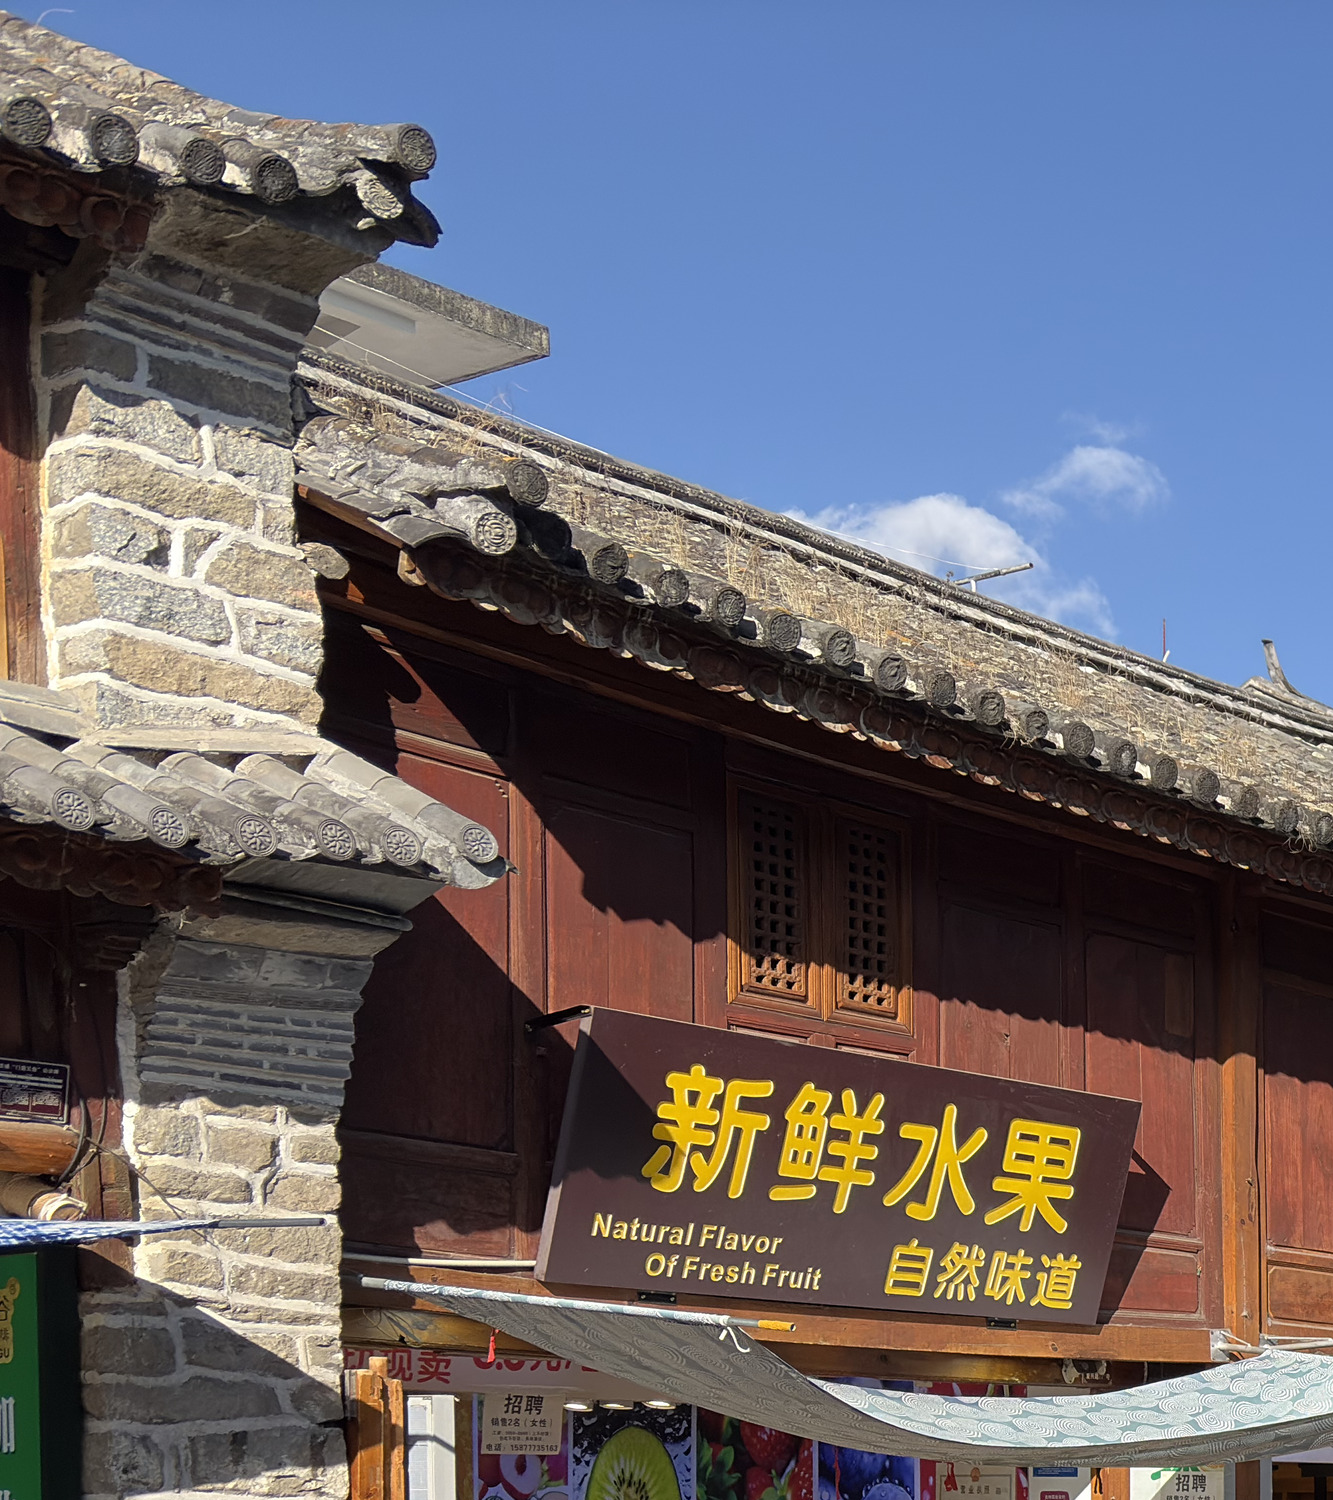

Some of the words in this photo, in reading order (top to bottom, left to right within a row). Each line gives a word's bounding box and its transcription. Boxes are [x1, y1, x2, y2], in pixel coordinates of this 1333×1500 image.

[641, 1062, 1082, 1235] 新鲜水果
[591, 1211, 692, 1247] Natural
[698, 1222, 783, 1257] Flavor
[644, 1251, 681, 1279] Of
[681, 1255, 756, 1286] Fresh
[760, 1262, 822, 1293] Fruit
[884, 1237, 1082, 1311] 自然味道
[504, 1393, 544, 1415] 招聘
[1175, 1473, 1207, 1493] 招聘
